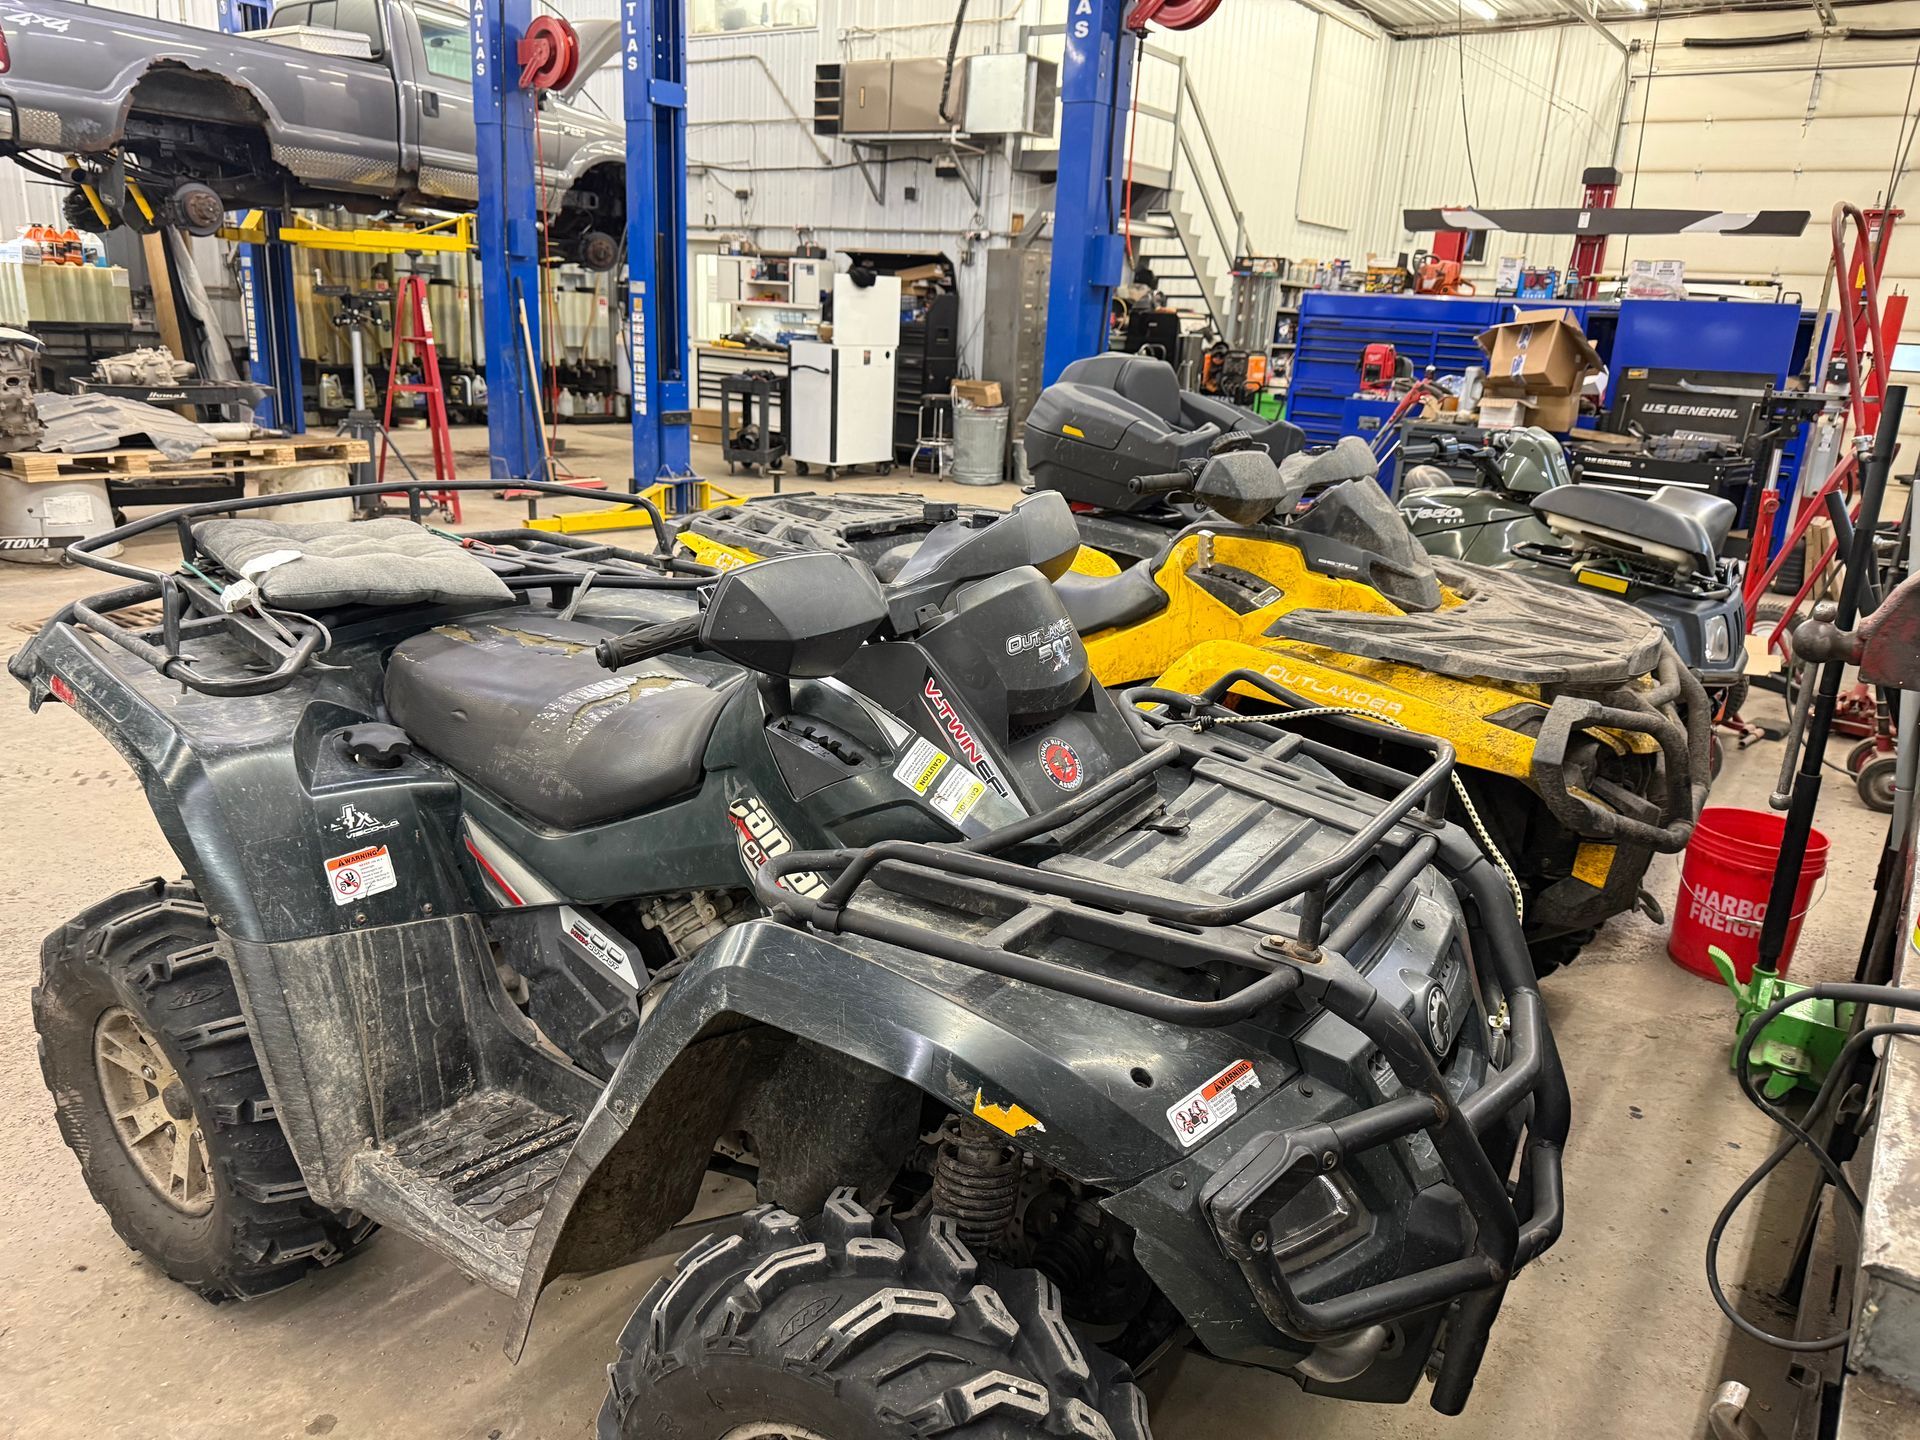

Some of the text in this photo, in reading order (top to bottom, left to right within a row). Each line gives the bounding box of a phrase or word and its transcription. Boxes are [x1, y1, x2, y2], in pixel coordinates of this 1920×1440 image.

[474, 0, 486, 76] ATLAS
[1667, 404, 1739, 419] GENERAL
[1263, 664, 1404, 715] OUTLANDER
[924, 677, 983, 765] V-TWIN
[919, 758, 942, 787] CAUTION
[344, 849, 378, 865] WARNING
[572, 919, 624, 965] 500
[587, 943, 620, 971] OUTPUT
[1219, 1062, 1250, 1088] WARNING
